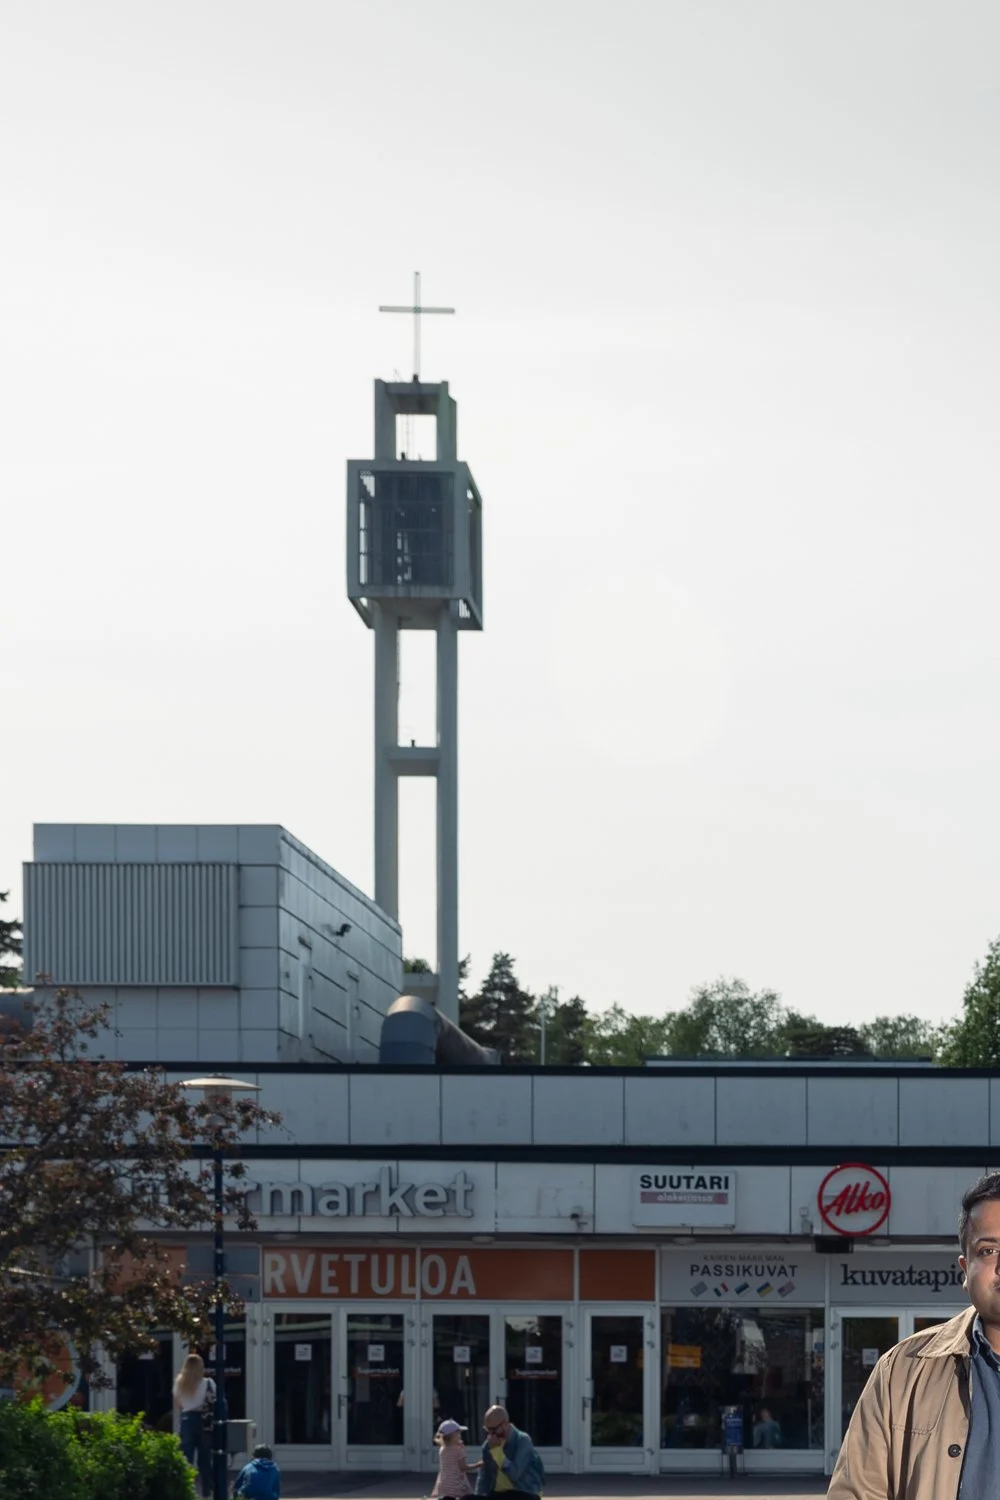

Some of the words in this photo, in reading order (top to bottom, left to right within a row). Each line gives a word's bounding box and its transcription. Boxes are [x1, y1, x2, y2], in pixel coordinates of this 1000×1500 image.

[225, 1165, 475, 1218] rmarket
[640, 1174, 729, 1190] SUUTARI
[823, 1181, 886, 1216] Alko
[689, 1264, 798, 1277] PASSIKUVAT
